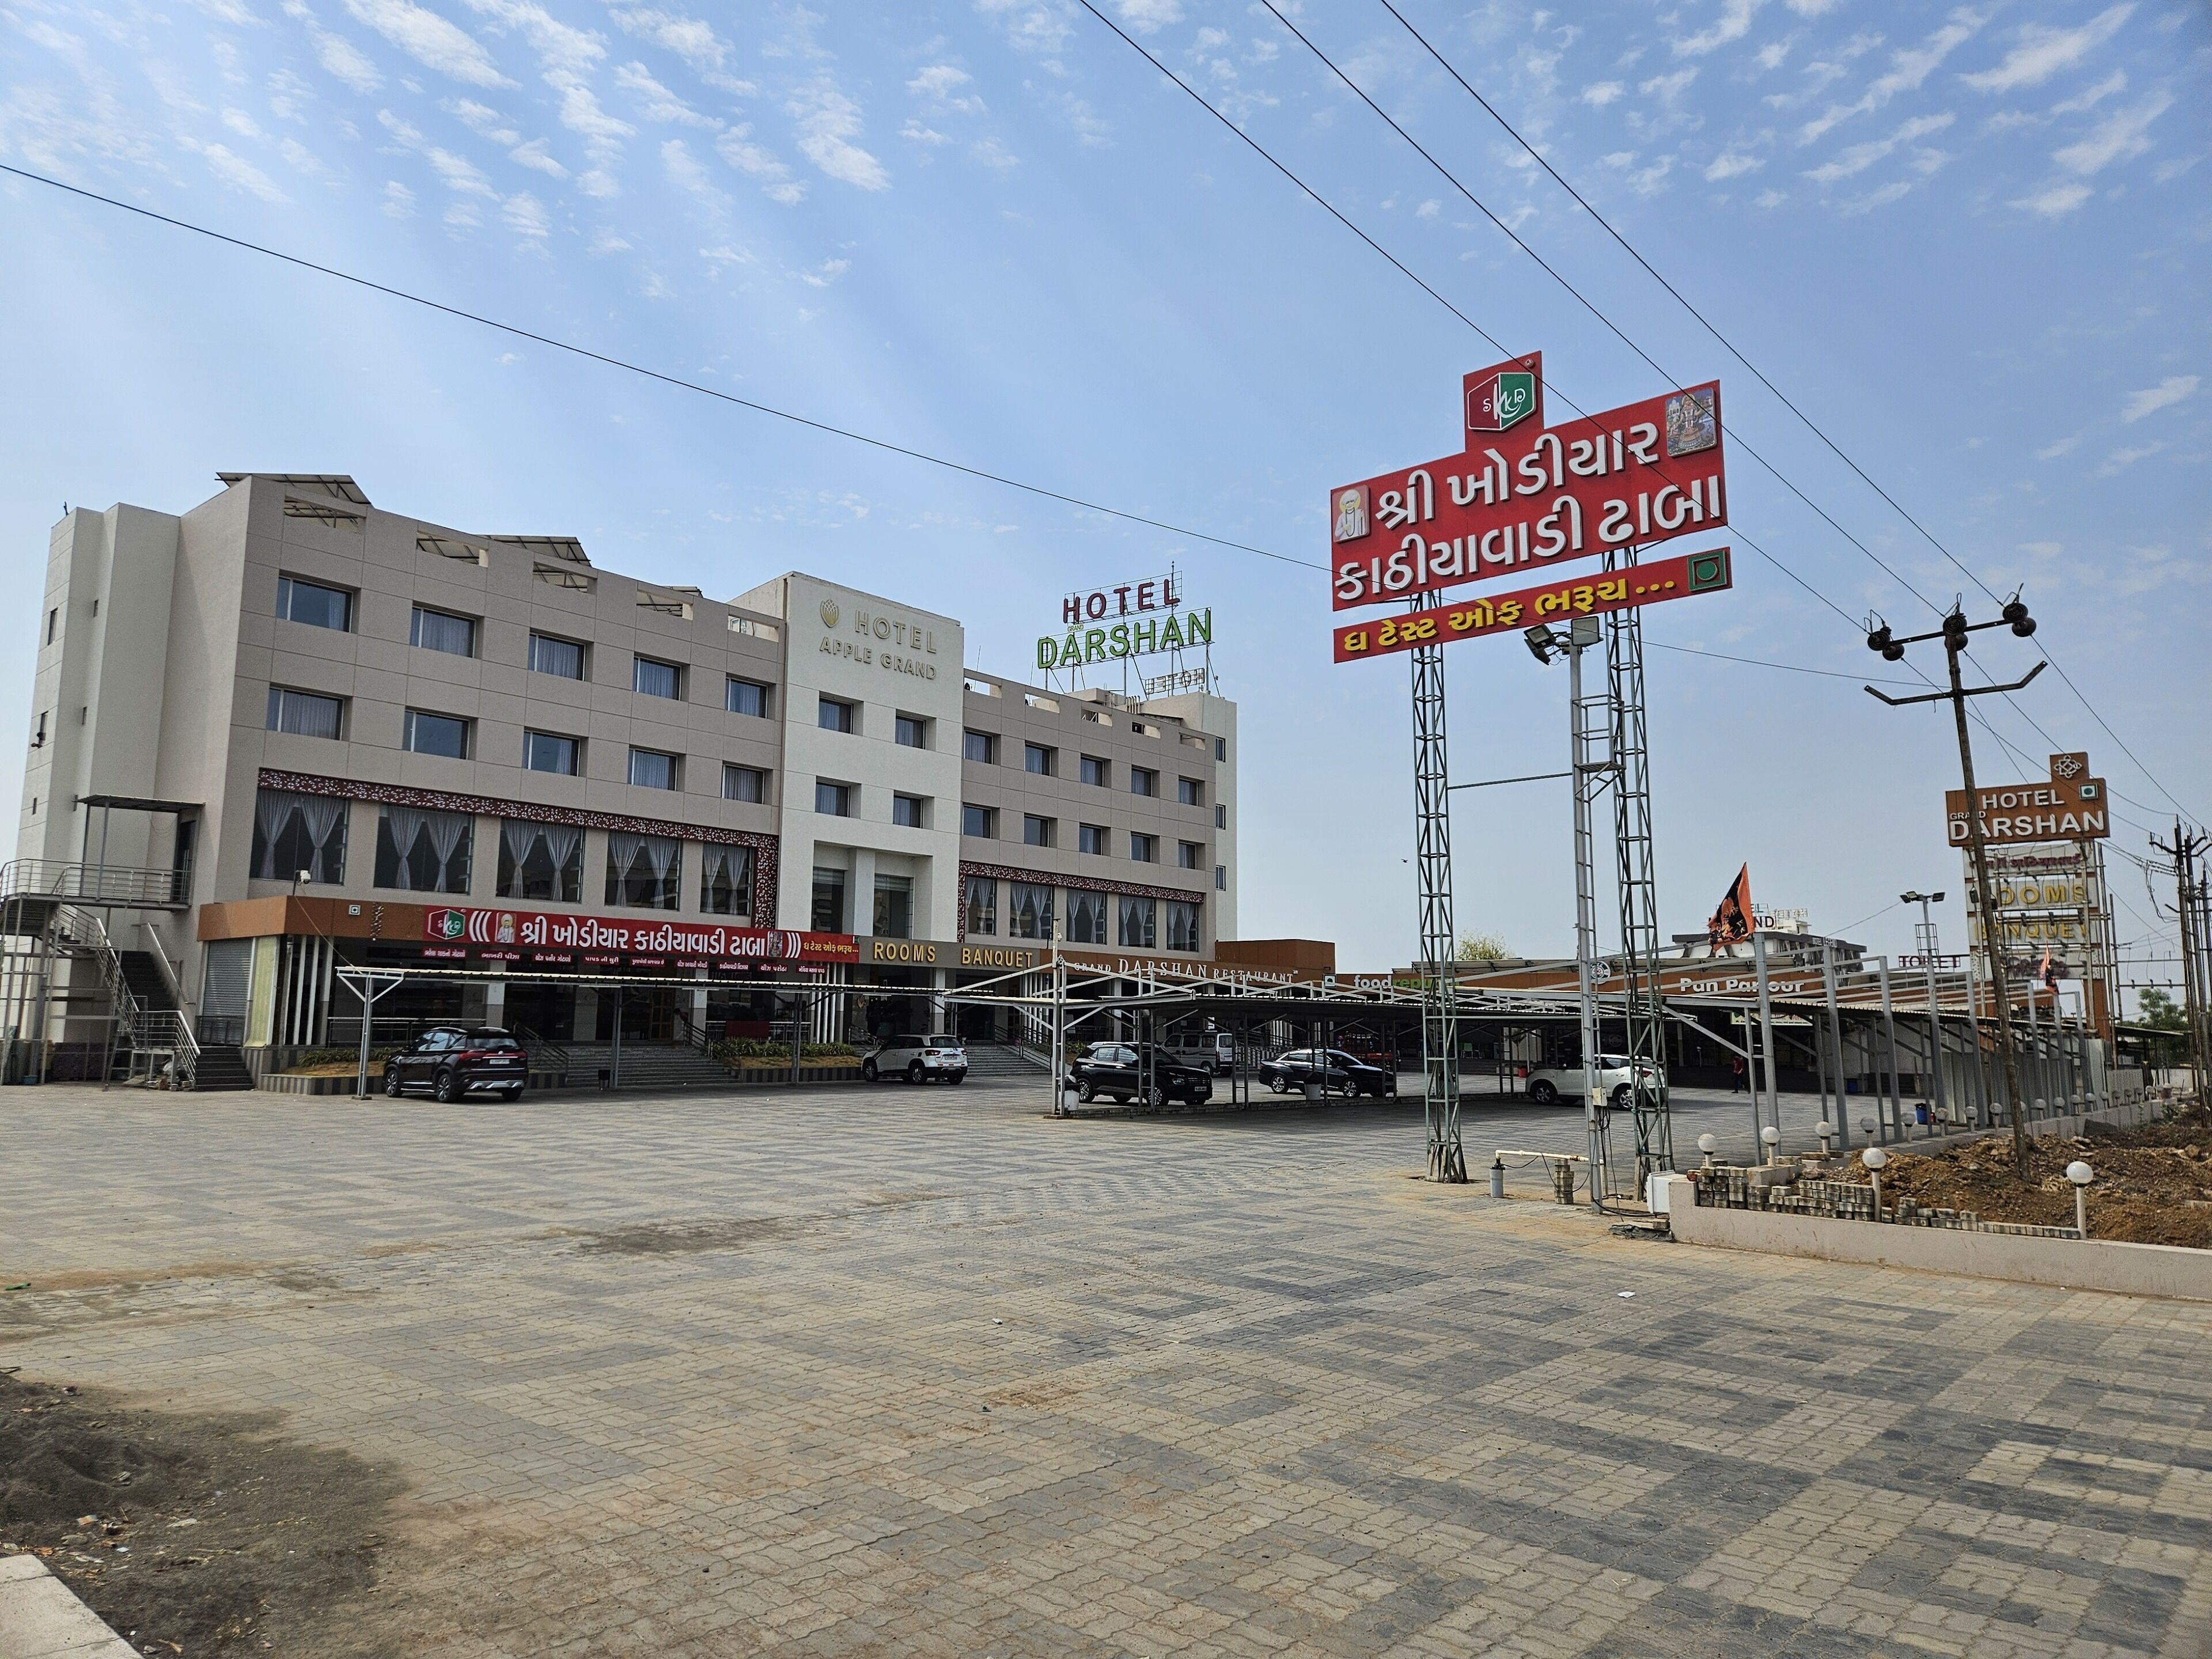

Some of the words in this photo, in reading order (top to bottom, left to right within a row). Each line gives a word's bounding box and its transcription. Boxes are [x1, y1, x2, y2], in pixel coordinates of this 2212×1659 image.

[1376, 469, 1433, 530] શ્રી
[1447, 422, 1659, 507] ખોડીયાર
[1335, 494, 1584, 600] કાઠીયાવાડી
[1599, 476, 1722, 543] ઢાબા
[1063, 579, 1180, 623] HOTEL
[855, 609, 937, 653] HOTEL
[1037, 609, 1211, 669] DARSHAN
[1067, 624, 1084, 632] GRAND
[1378, 619, 1438, 646] ટેસ્ટ
[1449, 598, 1524, 631] ઓફ
[820, 637, 872, 664] APPLE
[880, 653, 937, 679] GRAND
[1982, 789, 2065, 809] HOTEL
[520, 916, 547, 945] શ્રી
[552, 918, 629, 949] ખોડીયાર
[634, 924, 725, 955] કાઠીયાવાડી
[729, 934, 765, 956] ઢાબા
[810, 941, 821, 950] ટેસ્ટ
[823, 941, 836, 953] ઓફ
[873, 942, 935, 962] ROOMS
[962, 948, 1033, 968] BANQUET
[1118, 959, 1207, 978] DARSHAN
[1680, 978, 1718, 992] Pan
[1726, 979, 1804, 993] Parour
